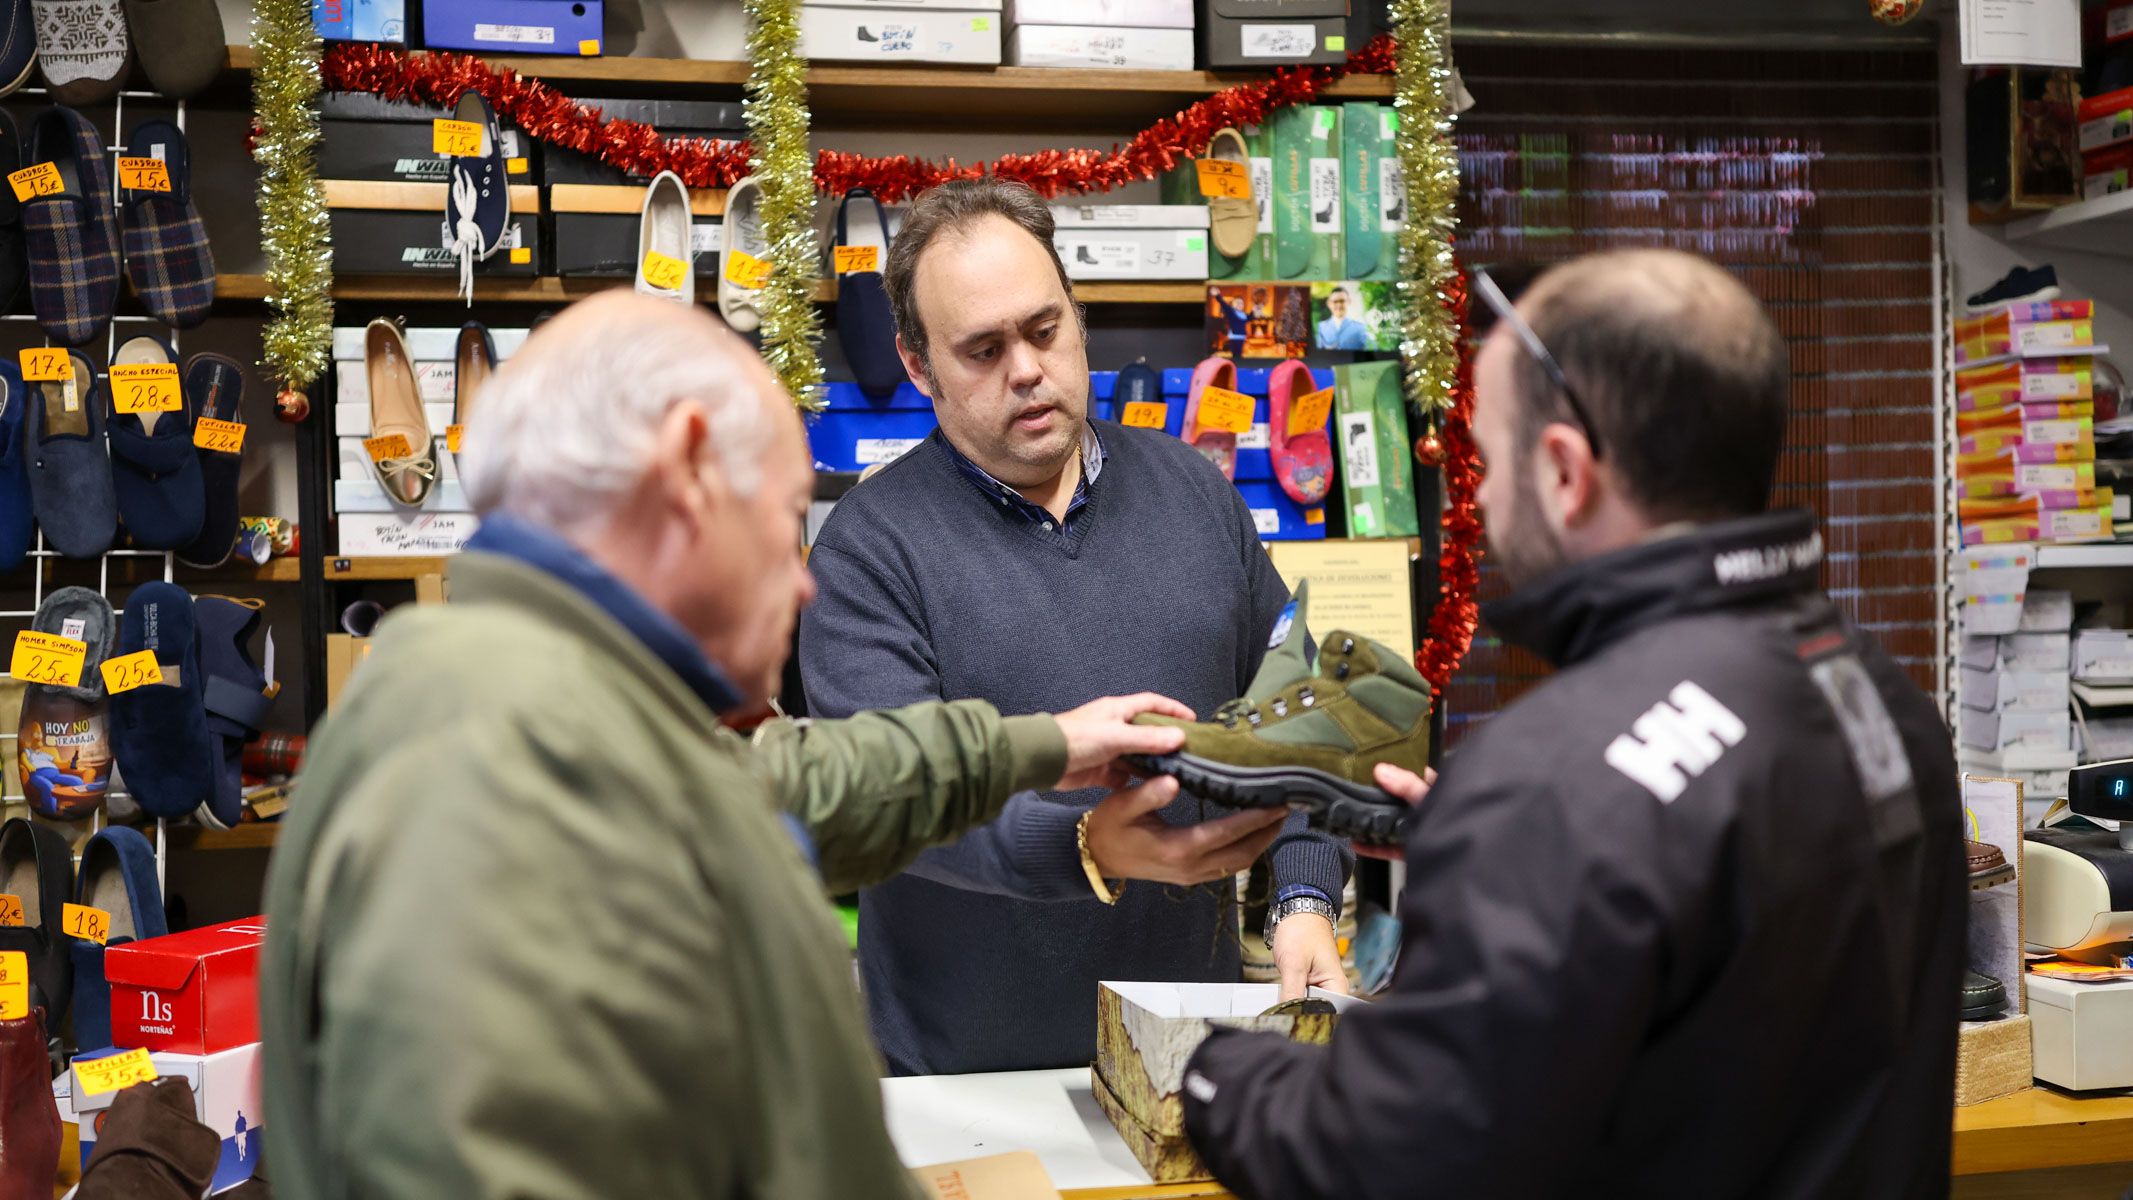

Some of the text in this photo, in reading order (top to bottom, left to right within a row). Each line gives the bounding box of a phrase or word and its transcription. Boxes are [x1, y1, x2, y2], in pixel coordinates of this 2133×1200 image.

[447, 135, 478, 153] 15€
[121, 160, 163, 168] CUADROS
[12, 166, 49, 181] CUADROS
[136, 171, 168, 188] 15€
[29, 176, 59, 196] 15€
[648, 260, 681, 285] 15€
[30, 355, 68, 376] 17€
[113, 368, 137, 377] ANCHO
[131, 385, 171, 409] 28€
[204, 431, 239, 449] 22€
[433, 520, 455, 528] JAM
[20, 635, 47, 646] HOMER
[26, 655, 71, 684] 25€
[115, 659, 159, 690] 25€
[45, 720, 89, 734] HOY NO
[58, 734, 96, 745] TRABAJA
[2114, 780, 2124, 796] A
[74, 911, 106, 939] 18€
[140, 990, 173, 1022] ns
[140, 1025, 174, 1036] NORTEÑAS
[97, 1066, 148, 1088] 35€
